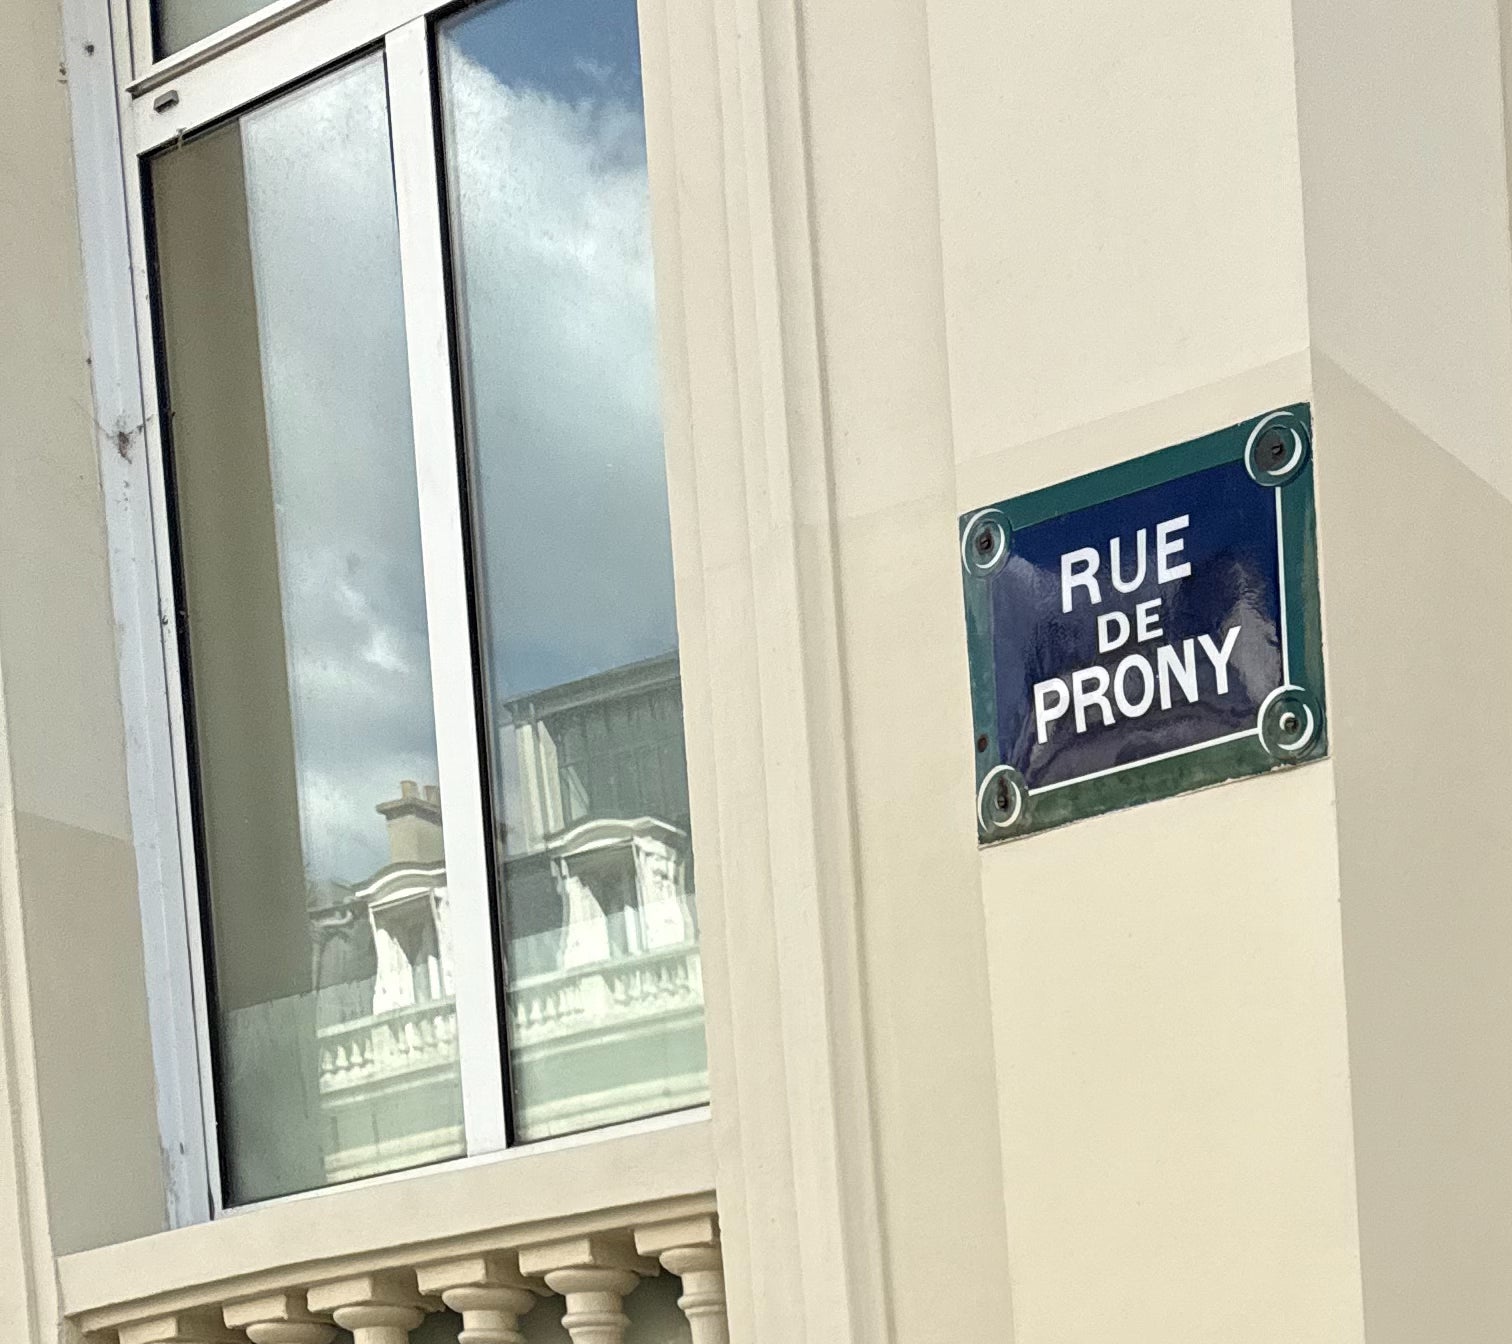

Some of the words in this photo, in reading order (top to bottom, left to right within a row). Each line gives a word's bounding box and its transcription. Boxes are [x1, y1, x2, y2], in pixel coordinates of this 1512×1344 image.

[1061, 514, 1191, 613] RUE
[1097, 598, 1164, 653] DE
[1033, 626, 1242, 745] PRONY
